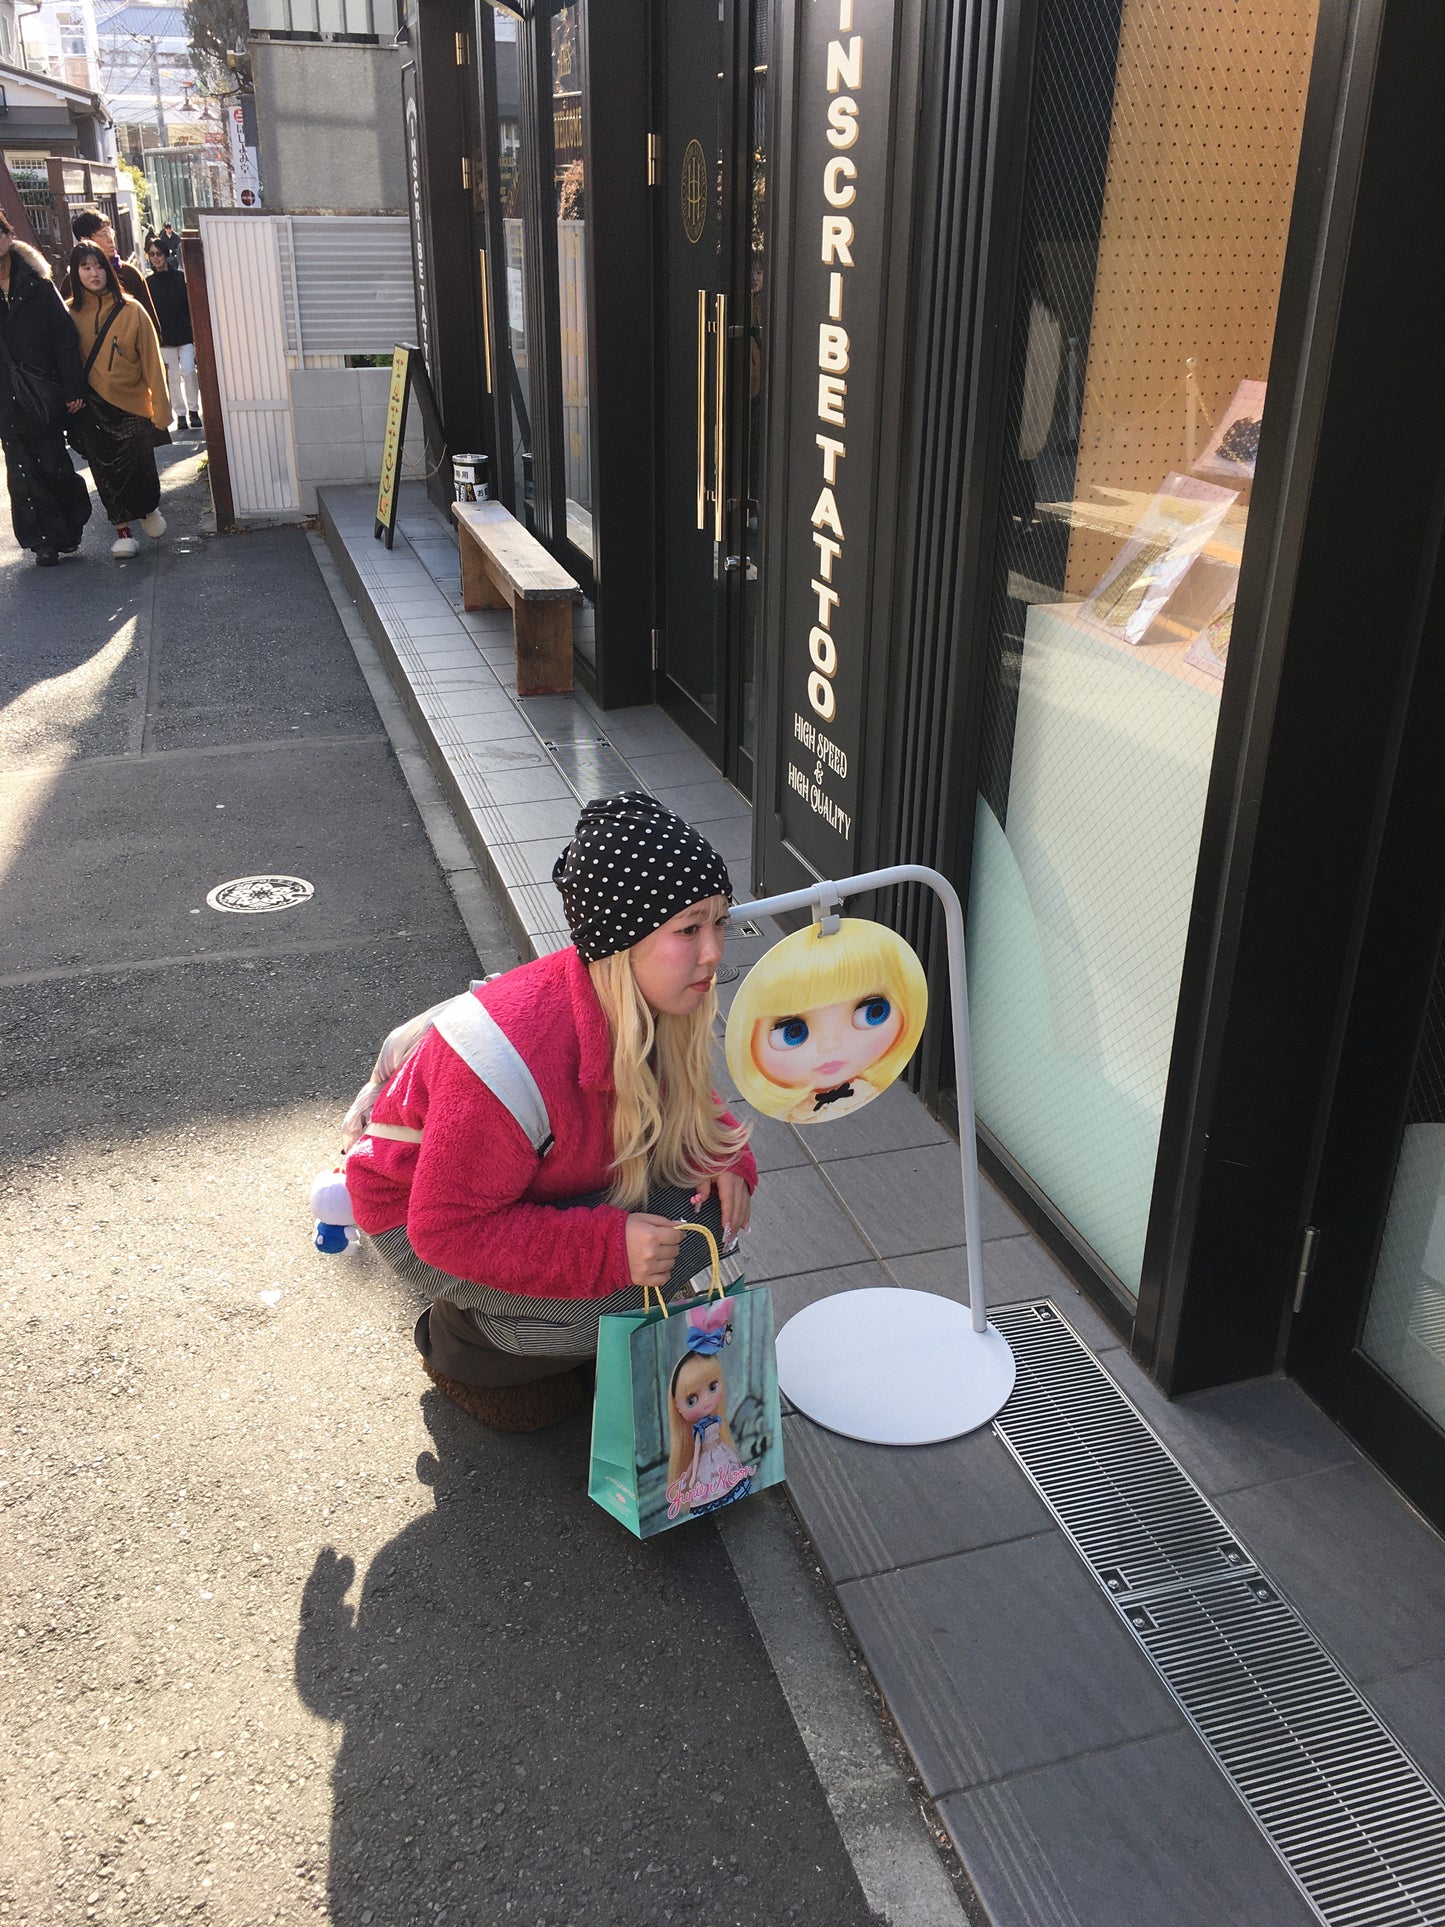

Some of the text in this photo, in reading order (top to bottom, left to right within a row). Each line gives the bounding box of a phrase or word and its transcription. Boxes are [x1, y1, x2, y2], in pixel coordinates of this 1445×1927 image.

[410, 119, 424, 280] INSCRIBE
[807, 0, 863, 723] INSCRIBE TATTOO
[383, 358, 404, 493] TATTOO
[794, 712, 848, 779] HIGH SPEED
[813, 760, 824, 785] &
[788, 762, 852, 840] HIGH QUALITY
[666, 1471, 708, 1520] Junie
[709, 1463, 757, 1495] Moon
